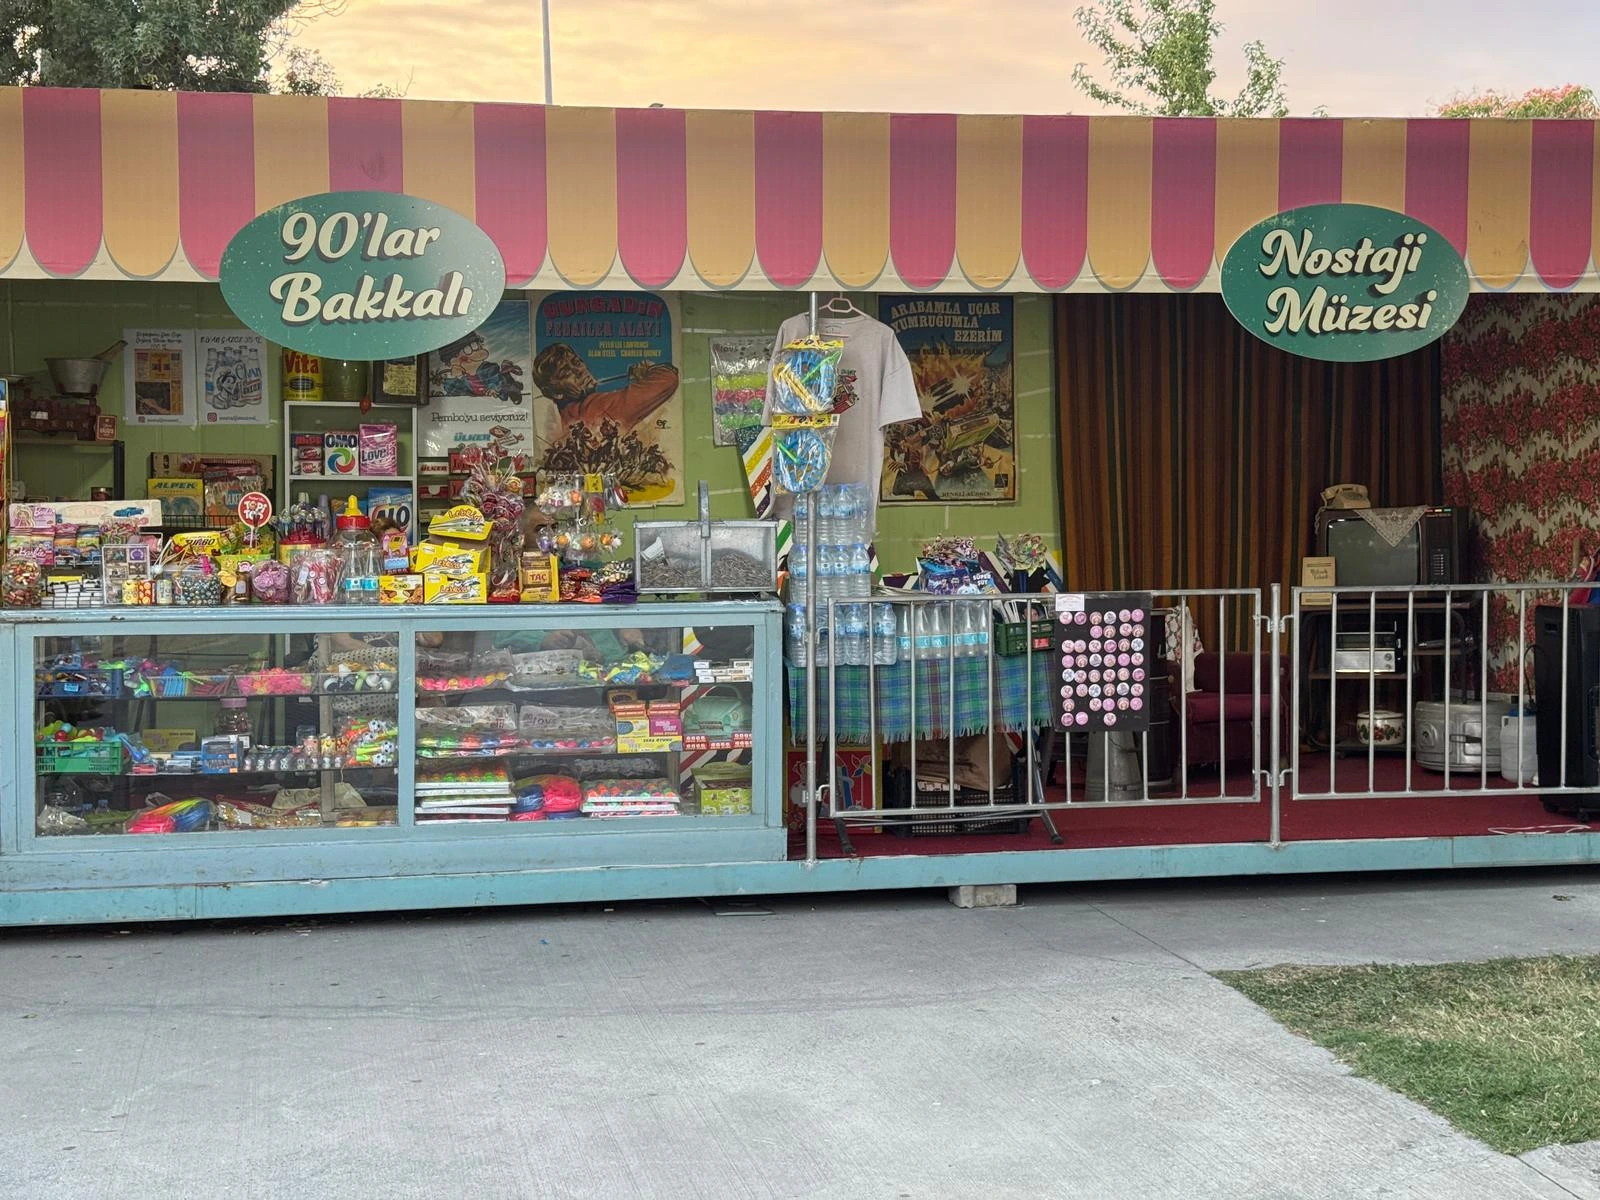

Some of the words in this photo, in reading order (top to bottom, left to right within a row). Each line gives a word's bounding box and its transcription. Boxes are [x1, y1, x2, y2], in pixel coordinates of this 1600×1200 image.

[281, 211, 441, 262] 90'lar
[1258, 228, 1428, 297] Nostaji
[269, 271, 473, 324] Bakkalı
[890, 301, 961, 319] ARABAMLA
[967, 302, 1001, 318] UÇAR
[1264, 285, 1438, 335] Müzesi
[953, 328, 1003, 342] EZERİM
[284, 351, 319, 374] Vita
[479, 412, 529, 424] seviyoruz!
[325, 434, 357, 448] OMO
[453, 431, 491, 442] ÜLKER
